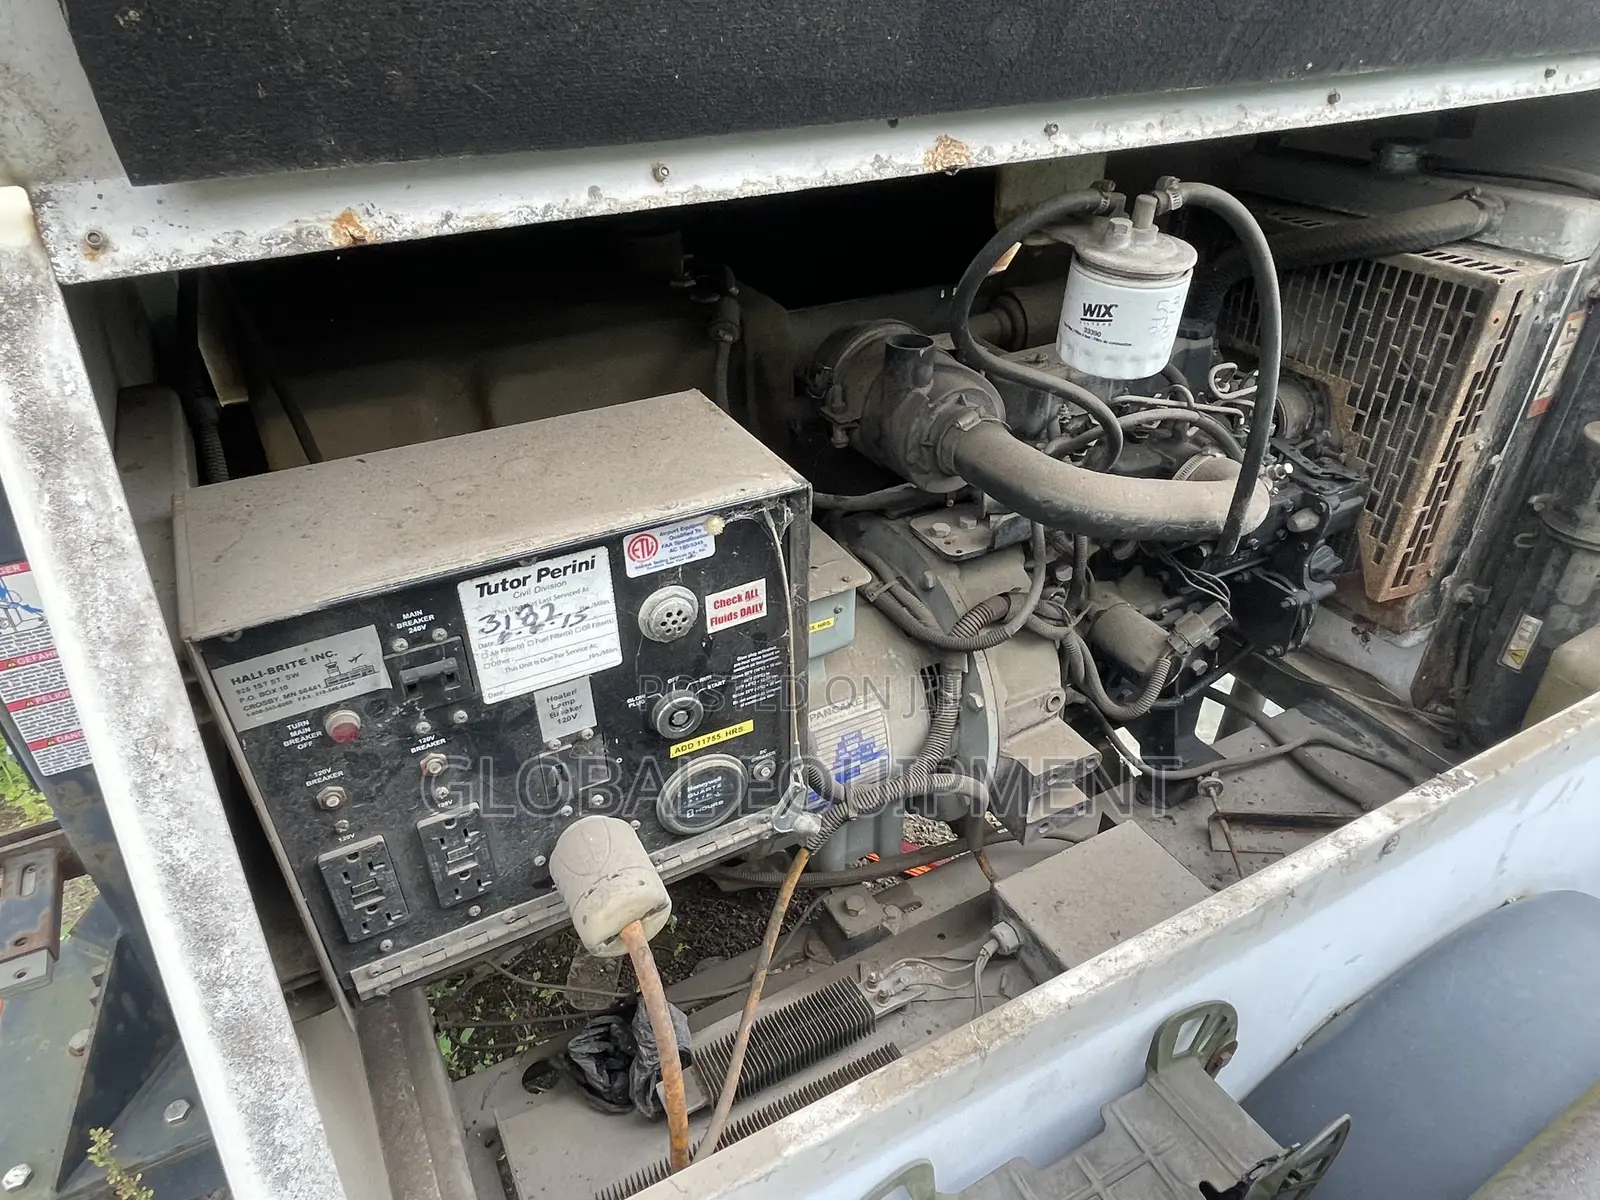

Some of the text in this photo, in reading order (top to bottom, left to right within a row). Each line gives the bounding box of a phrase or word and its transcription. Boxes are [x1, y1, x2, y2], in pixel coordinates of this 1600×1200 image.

[1082, 302, 1114, 318] WIX
[1083, 326, 1102, 338] 33390
[661, 542, 674, 550] FAA
[475, 555, 596, 599] Tutor Perini
[512, 579, 568, 600] Civil Division
[553, 588, 582, 601] Serviced
[713, 587, 760, 611] Check ALL
[396, 613, 436, 630] BREAKER
[402, 608, 424, 620] MAIN
[709, 601, 765, 628] Fluids DAILY
[407, 623, 428, 635] 240V
[489, 649, 500, 658] Air
[535, 636, 549, 646] Fuel
[504, 664, 519, 675] This
[518, 661, 533, 671] Unit
[539, 655, 554, 665] Due
[553, 652, 566, 662] For
[565, 644, 588, 659] Service
[230, 649, 339, 687] HALI-BRITE INC.
[252, 680, 270, 692] 1ST
[269, 676, 284, 687] ST.
[285, 671, 300, 682] SW
[706, 679, 727, 691] START
[239, 684, 290, 704] P.O. BOX 10
[242, 697, 281, 713] CROSBY,
[282, 691, 298, 701] MN
[626, 693, 647, 704] GLOW
[549, 703, 583, 719] Braker
[550, 698, 576, 711] Lamp
[628, 699, 646, 709] PLUG
[286, 719, 311, 731] TURN
[557, 713, 578, 725] 120V
[282, 730, 324, 748] BREAKER
[289, 726, 312, 738] MAIN
[417, 734, 436, 745] 120V
[297, 741, 315, 751] OFF
[410, 738, 447, 754] BREAKER
[673, 742, 695, 756] ADD
[305, 770, 344, 787] BREAKER
[313, 766, 332, 777] 120V
[687, 775, 723, 792] Honeywell
[687, 783, 722, 799] QUARTZ
[695, 800, 725, 814] HOURS
